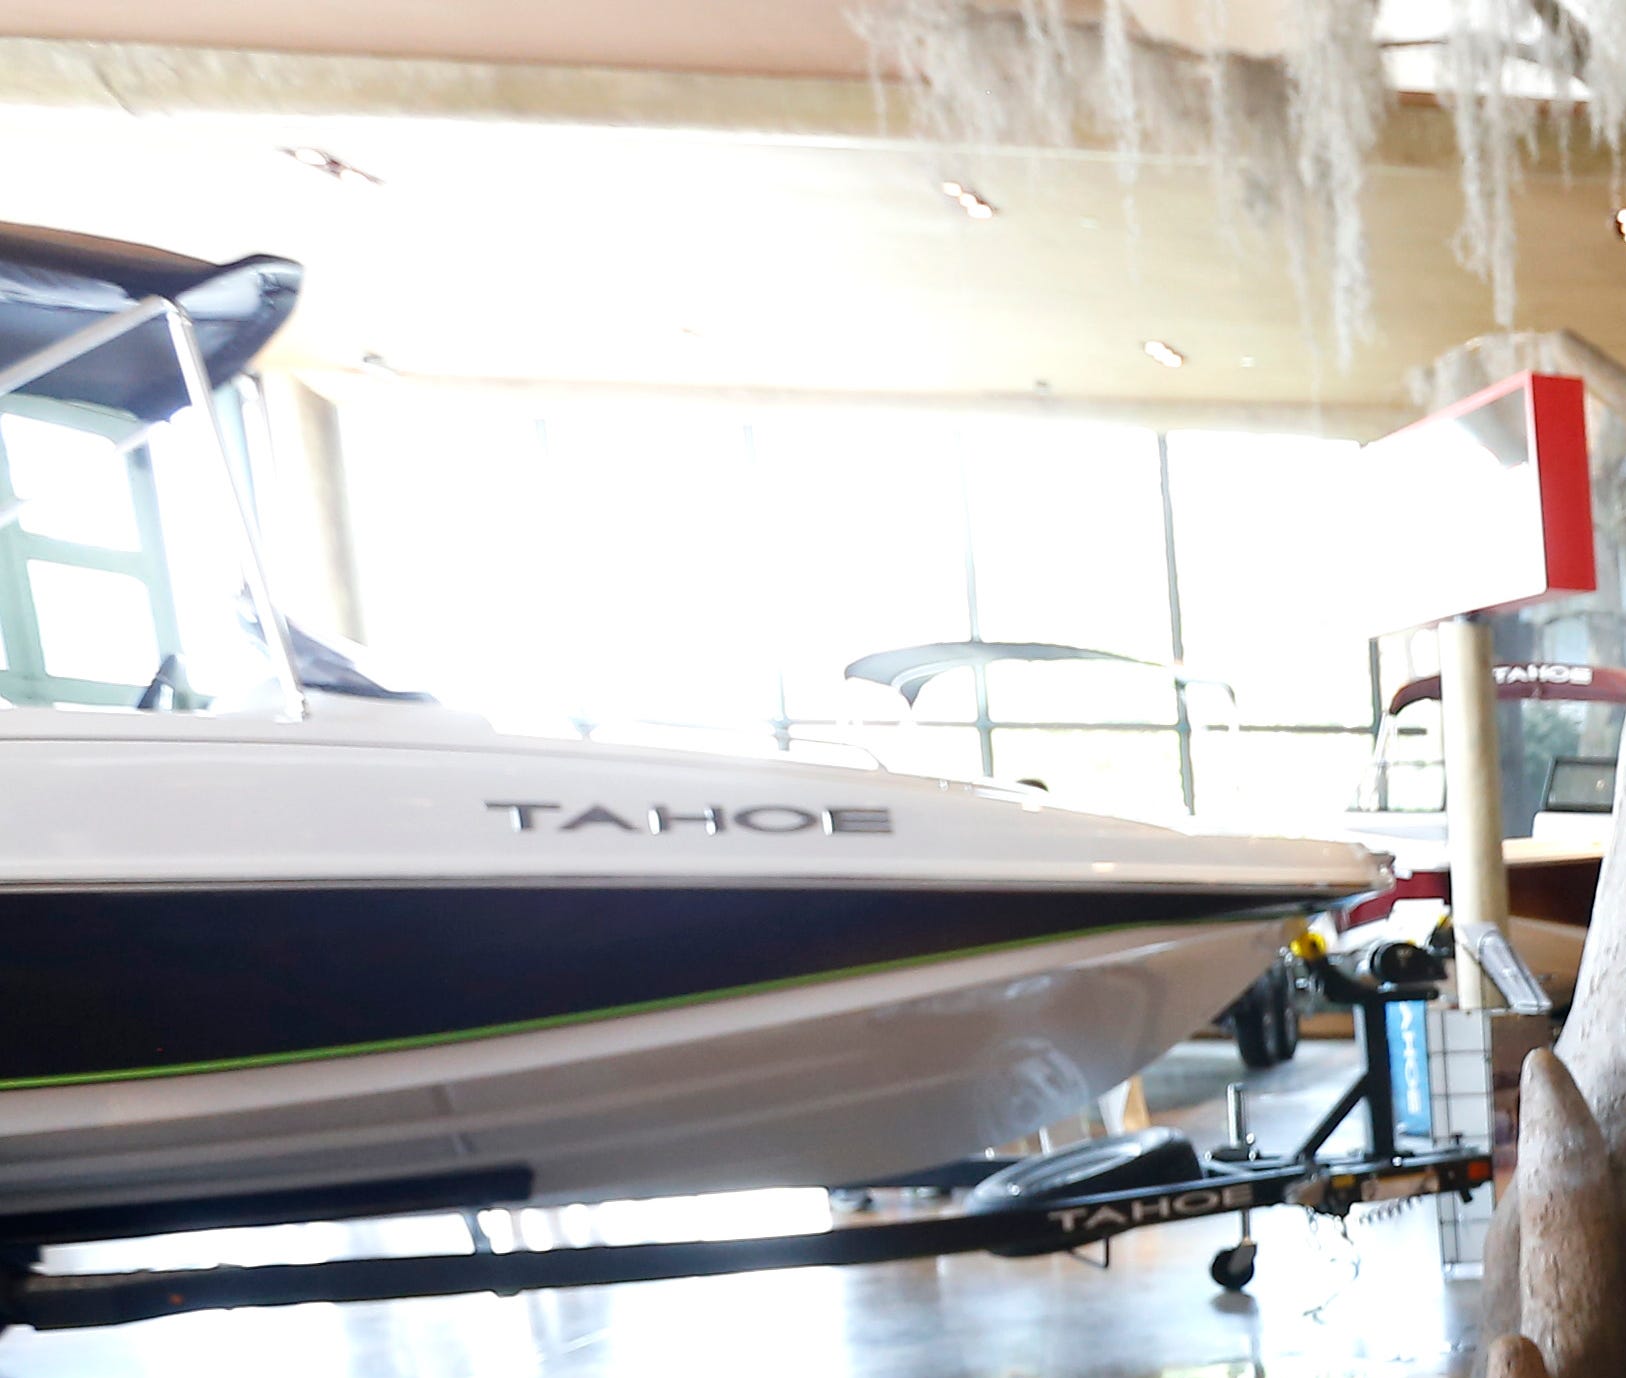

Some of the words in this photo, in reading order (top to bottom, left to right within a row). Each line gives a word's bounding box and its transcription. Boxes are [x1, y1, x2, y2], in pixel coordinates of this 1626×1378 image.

[1492, 664, 1594, 686] TAHOE
[485, 802, 893, 836] TAHOE
[1047, 1183, 1254, 1233] TAHOE
